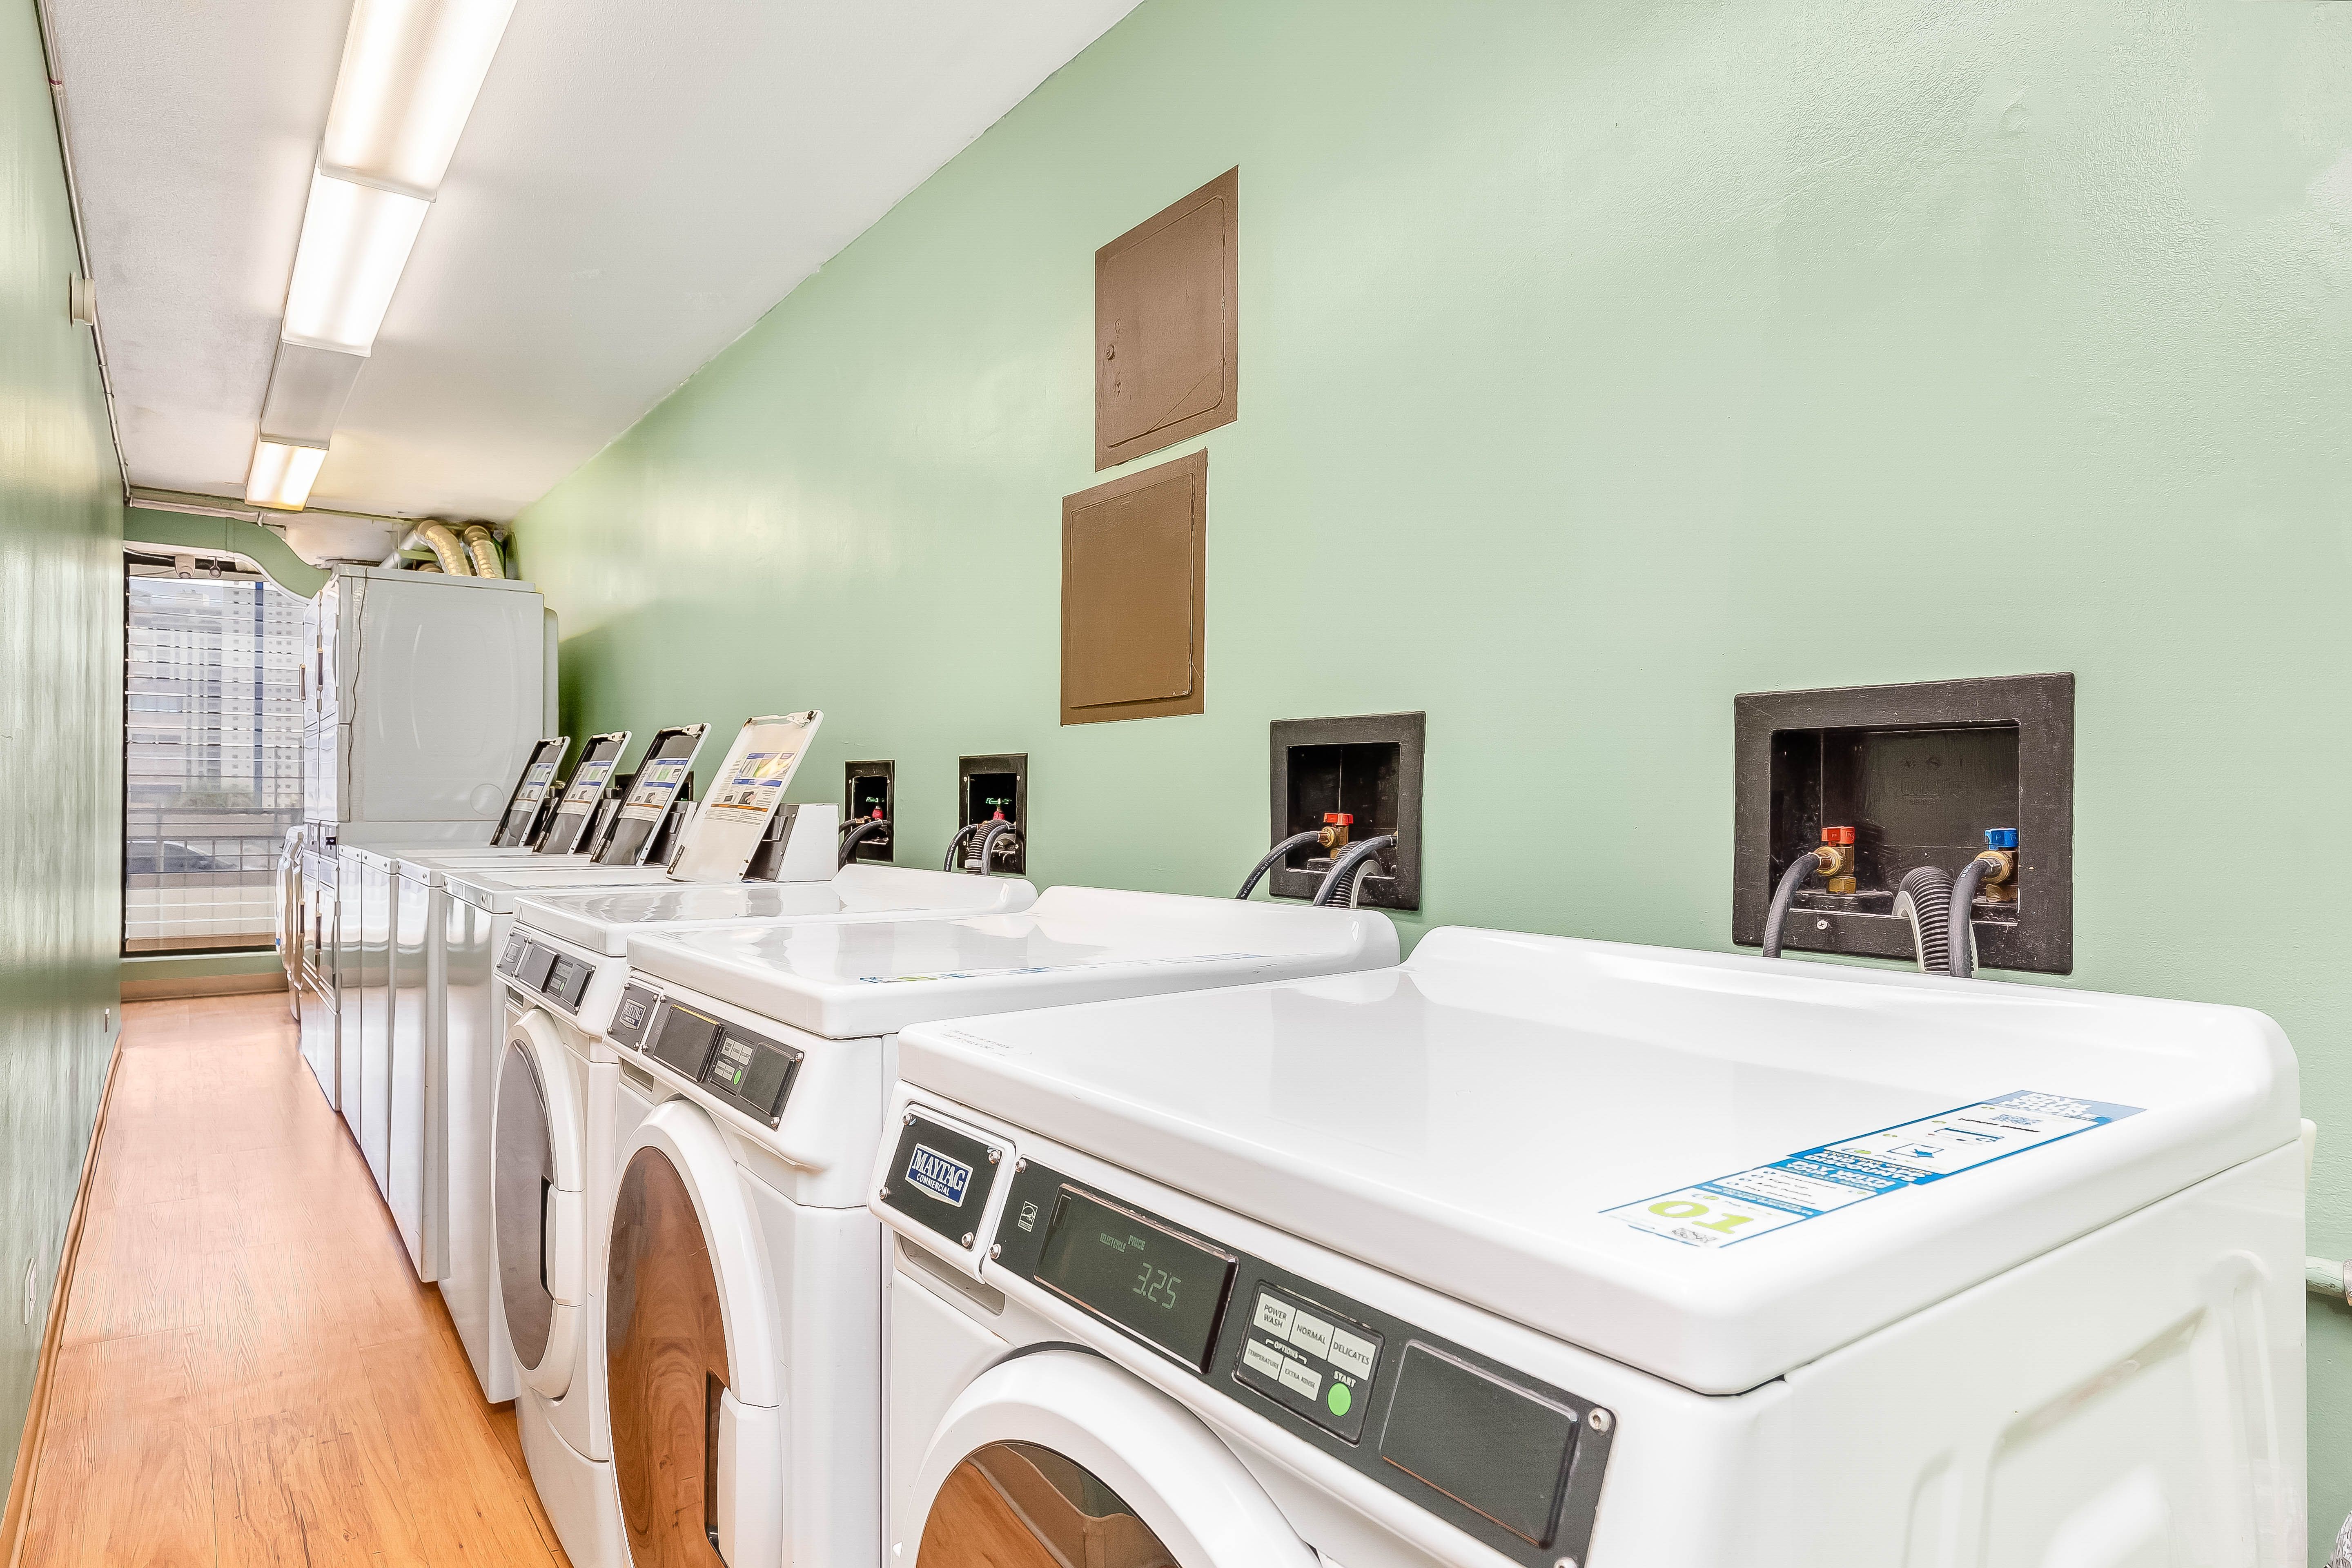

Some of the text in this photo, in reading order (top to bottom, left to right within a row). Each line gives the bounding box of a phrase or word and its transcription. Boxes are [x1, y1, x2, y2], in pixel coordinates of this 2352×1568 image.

[912, 1150, 965, 1191] MAYTAG
[1789, 1160, 1837, 1172] PAY
[1802, 1154, 1920, 1182] DISCOUNTS
[1811, 1152, 1858, 1163] AND
[1854, 1161, 1928, 1178] IN-APP
[917, 1173, 949, 1196] COMMERCIAL
[1648, 1201, 1754, 1234] 01
[1128, 1235, 1145, 1251] PRICE
[1133, 1262, 1181, 1310] 3.25
[1264, 1304, 1287, 1321] POWER
[1264, 1313, 1283, 1328] WASH
[1297, 1324, 1326, 1345] NORMAL
[1333, 1342, 1370, 1365] DELICATES
[1333, 1370, 1356, 1388] START
